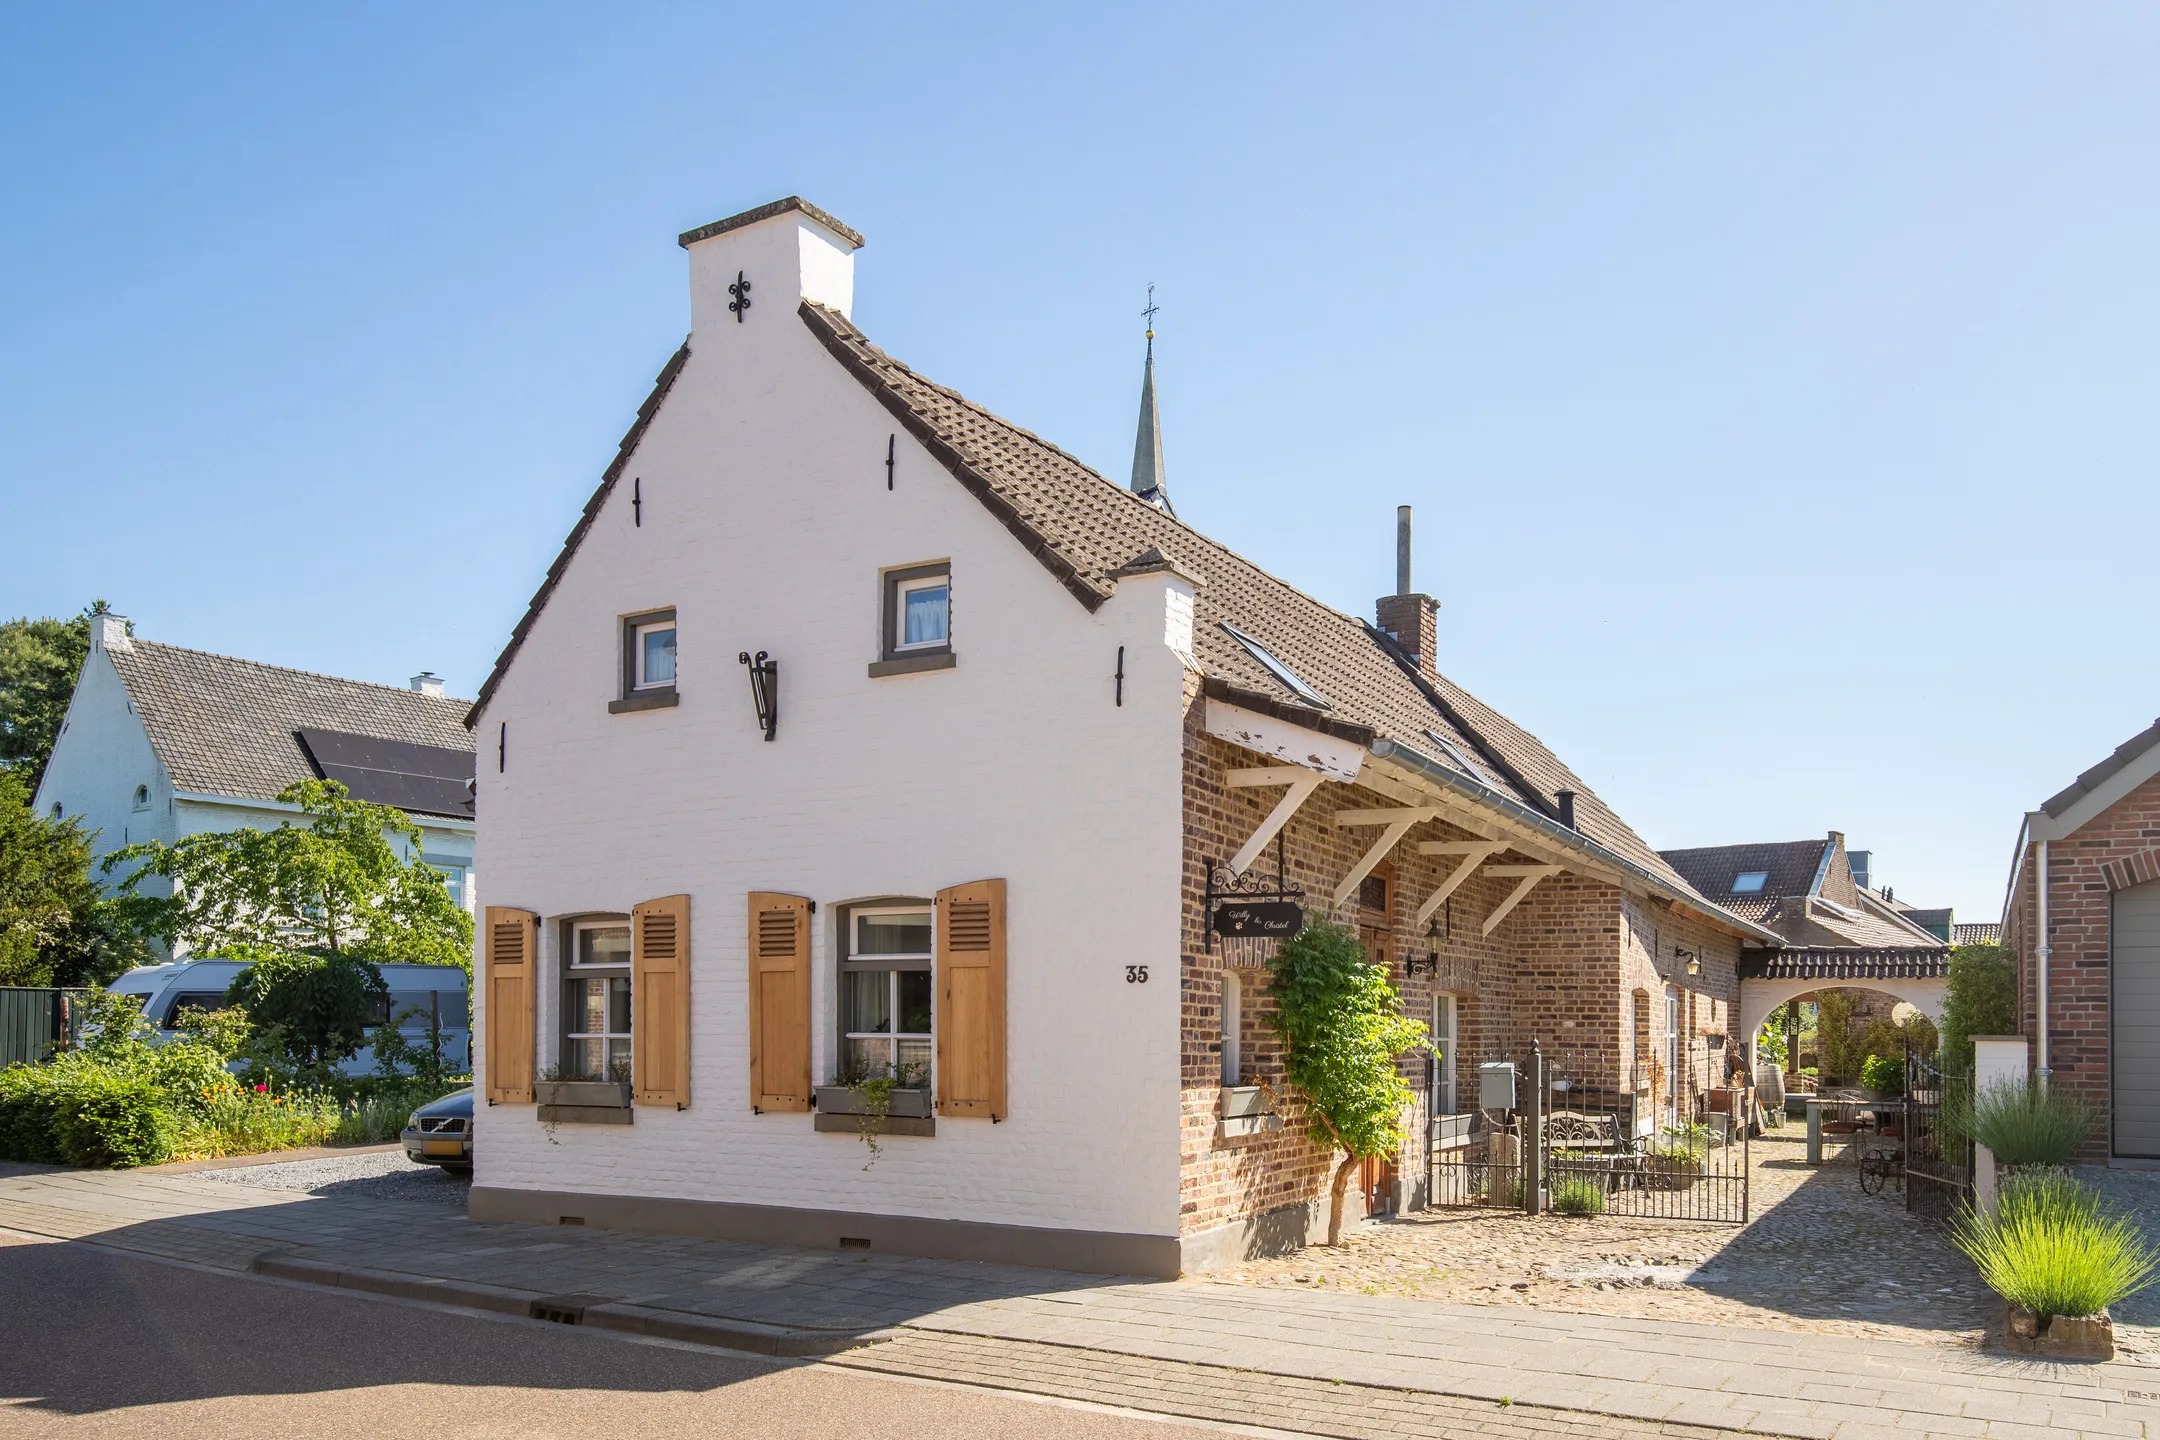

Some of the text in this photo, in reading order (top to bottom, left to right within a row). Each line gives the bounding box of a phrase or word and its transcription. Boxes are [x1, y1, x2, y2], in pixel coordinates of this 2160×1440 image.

[1228, 910, 1250, 922] Willy
[1264, 920, 1289, 930] Christel
[1125, 965, 1149, 984] 35
